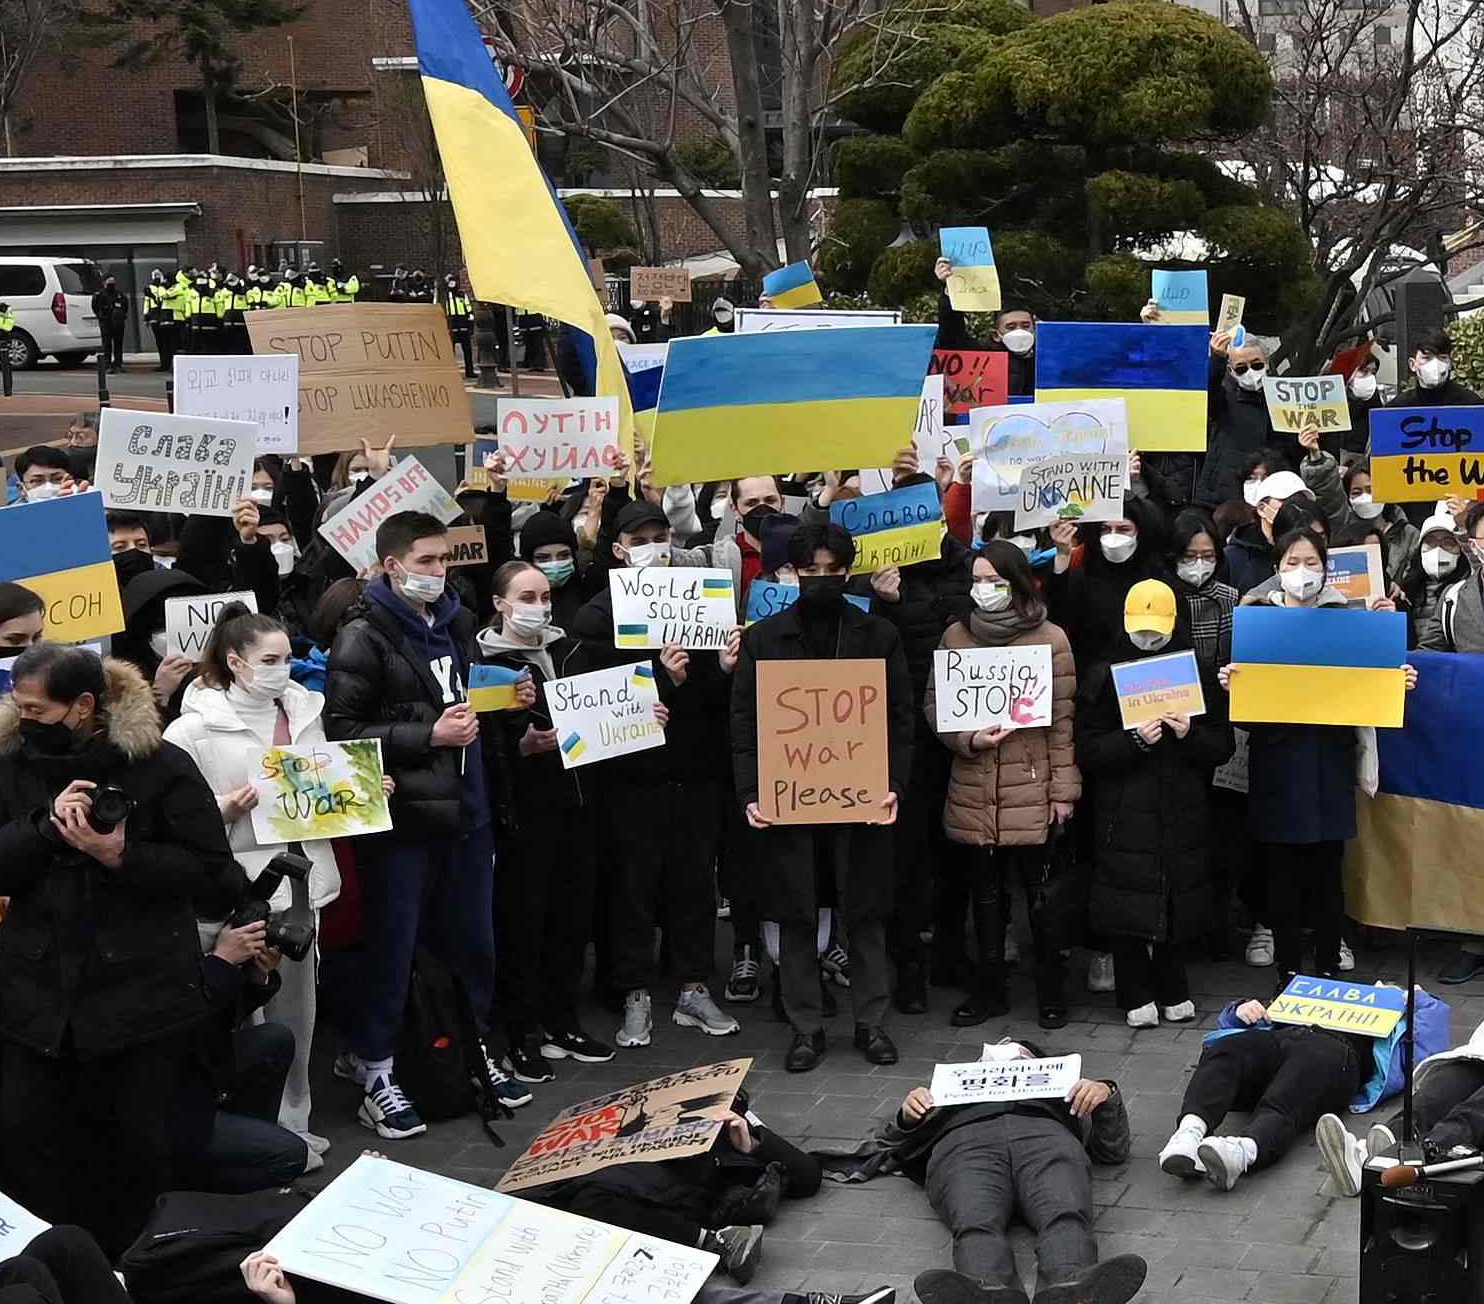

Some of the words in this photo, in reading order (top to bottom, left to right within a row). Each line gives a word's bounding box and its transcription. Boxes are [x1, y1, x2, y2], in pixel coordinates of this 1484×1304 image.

[269, 332, 342, 363] STOP
[361, 330, 441, 361] PUTIN
[350, 383, 451, 411] LUKASHENKO
[1276, 380, 1335, 403] STOP
[1282, 408, 1340, 429] WAR
[1401, 416, 1473, 451] Stop
[128, 424, 237, 467] Слава
[1030, 461, 1074, 484] STAND
[1079, 460, 1121, 474] WITH
[1403, 456, 1450, 486] the
[1022, 474, 1121, 512] UKRAINE
[842, 501, 932, 533] Слава
[619, 569, 697, 600] World
[946, 650, 1039, 683] Russia
[553, 677, 634, 714] Stand
[611, 702, 646, 718] with
[775, 685, 878, 736] STOP
[952, 684, 1022, 719] STOP
[773, 779, 873, 819] Please
[1289, 980, 1377, 1005] СЛАВА
[529, 1120, 621, 1156] WAR
[419, 1190, 494, 1242] Putin
[303, 1222, 388, 1271] NO
[383, 1248, 460, 1293] NO
